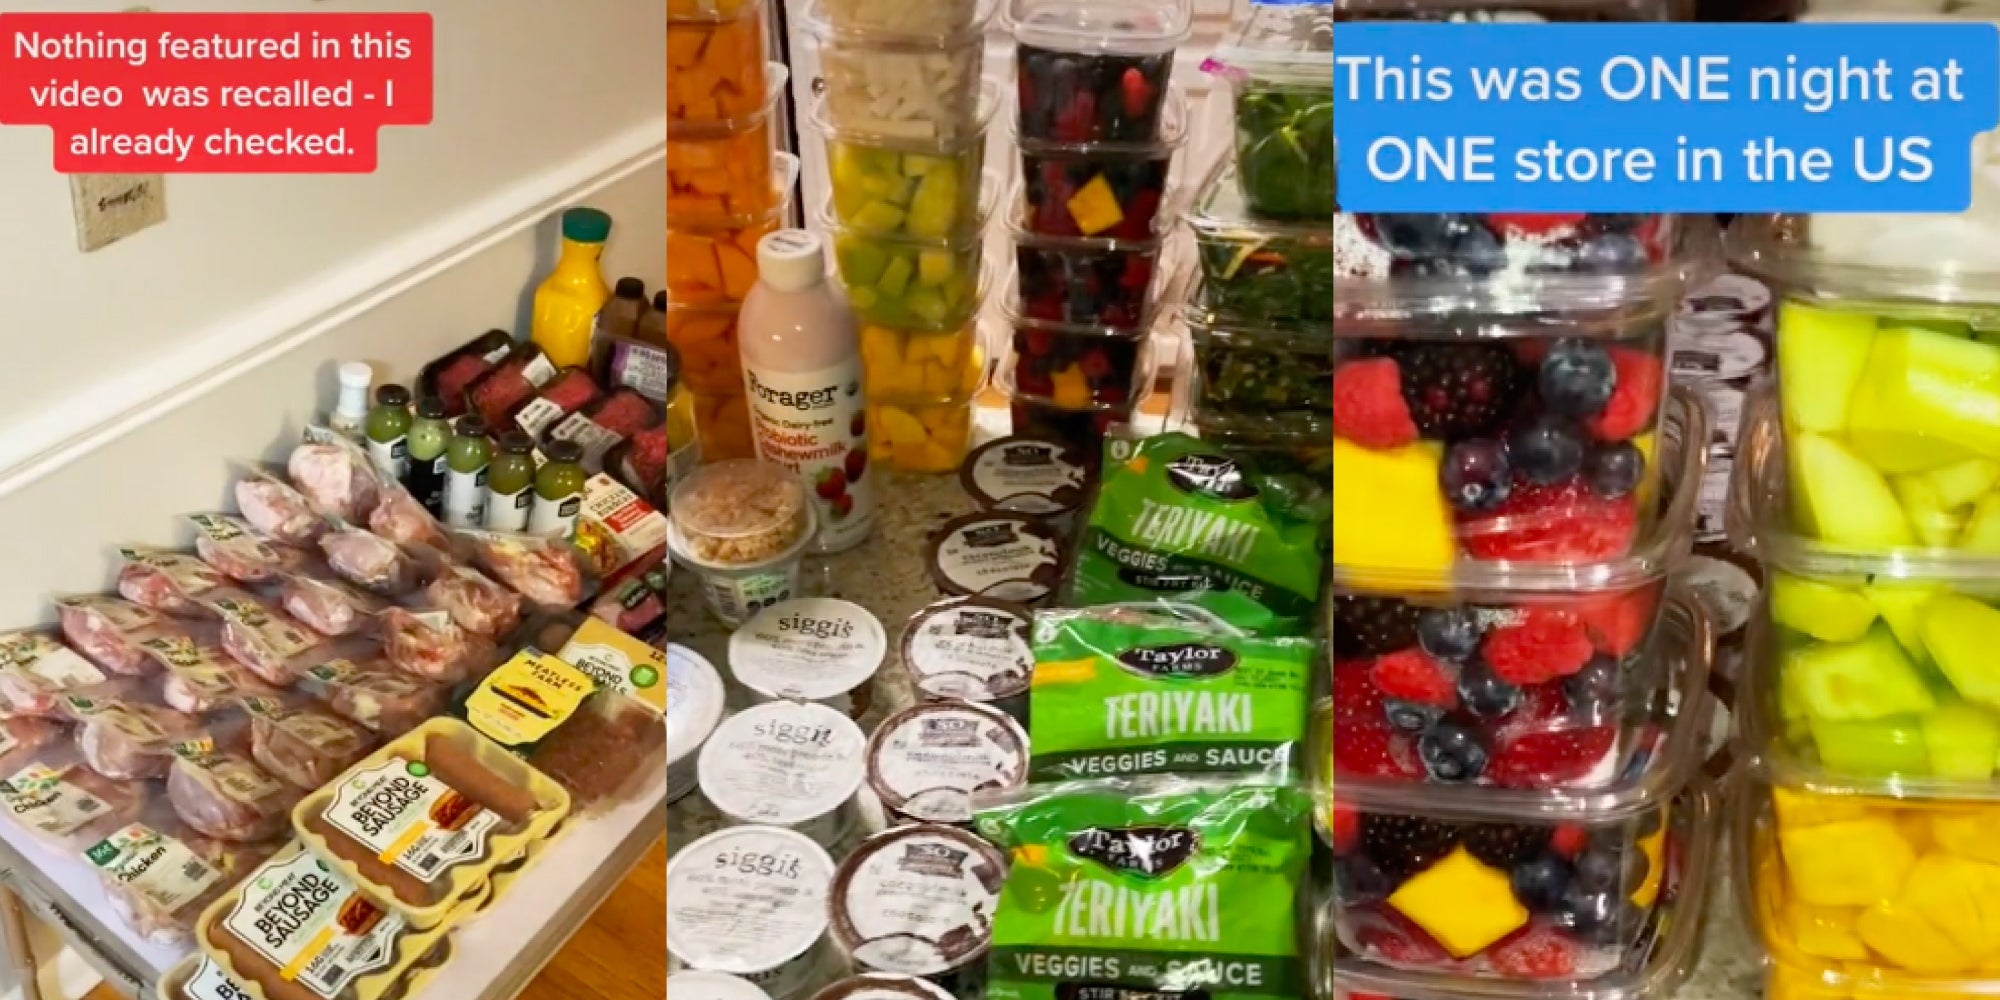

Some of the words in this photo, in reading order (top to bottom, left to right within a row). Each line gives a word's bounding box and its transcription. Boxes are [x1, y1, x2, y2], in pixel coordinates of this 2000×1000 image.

[1097, 533, 1169, 572] VEGGIES
[1131, 499, 1260, 563] TERIYAKI
[1135, 646, 1221, 664] Taylor
[1104, 689, 1253, 740] TERIYAKI
[1066, 750, 1168, 774] VEGGIES
[1173, 752, 1200, 763] AND
[1205, 747, 1292, 767] SAUCE
[351, 777, 410, 824] BEYOND
[361, 781, 430, 837] SAUSAGE
[253, 873, 321, 934] BEYOND
[265, 877, 340, 949] SAUSAGE
[1053, 877, 1221, 942] TERIYAKI
[1014, 952, 1120, 979] VEGGIES
